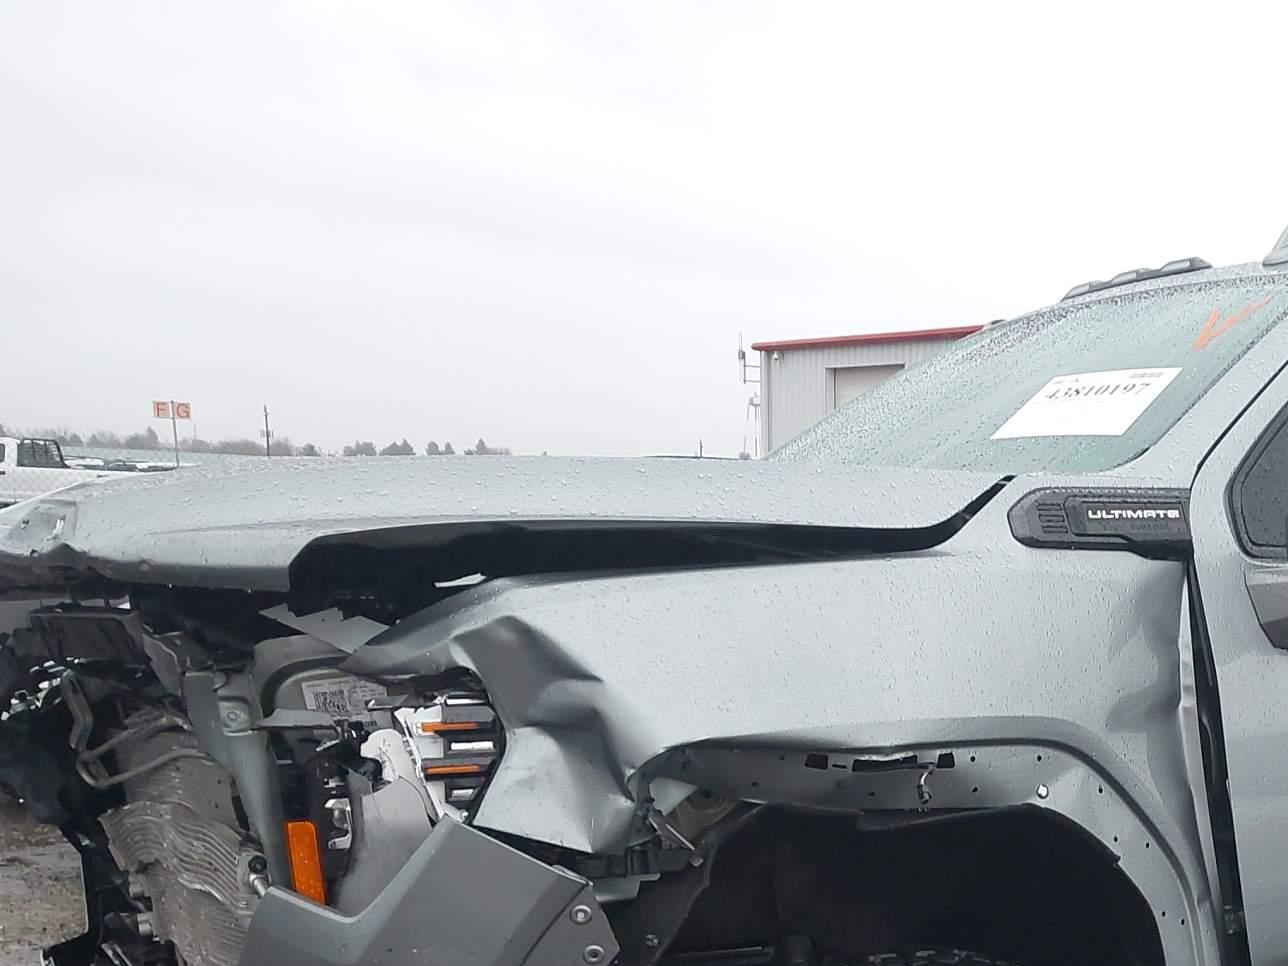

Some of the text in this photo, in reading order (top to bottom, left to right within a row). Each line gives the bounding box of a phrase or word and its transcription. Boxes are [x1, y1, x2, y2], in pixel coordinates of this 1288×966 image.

[156, 402, 168, 417] F
[176, 403, 190, 418] G
[1087, 509, 1180, 519] ULTIMATE
